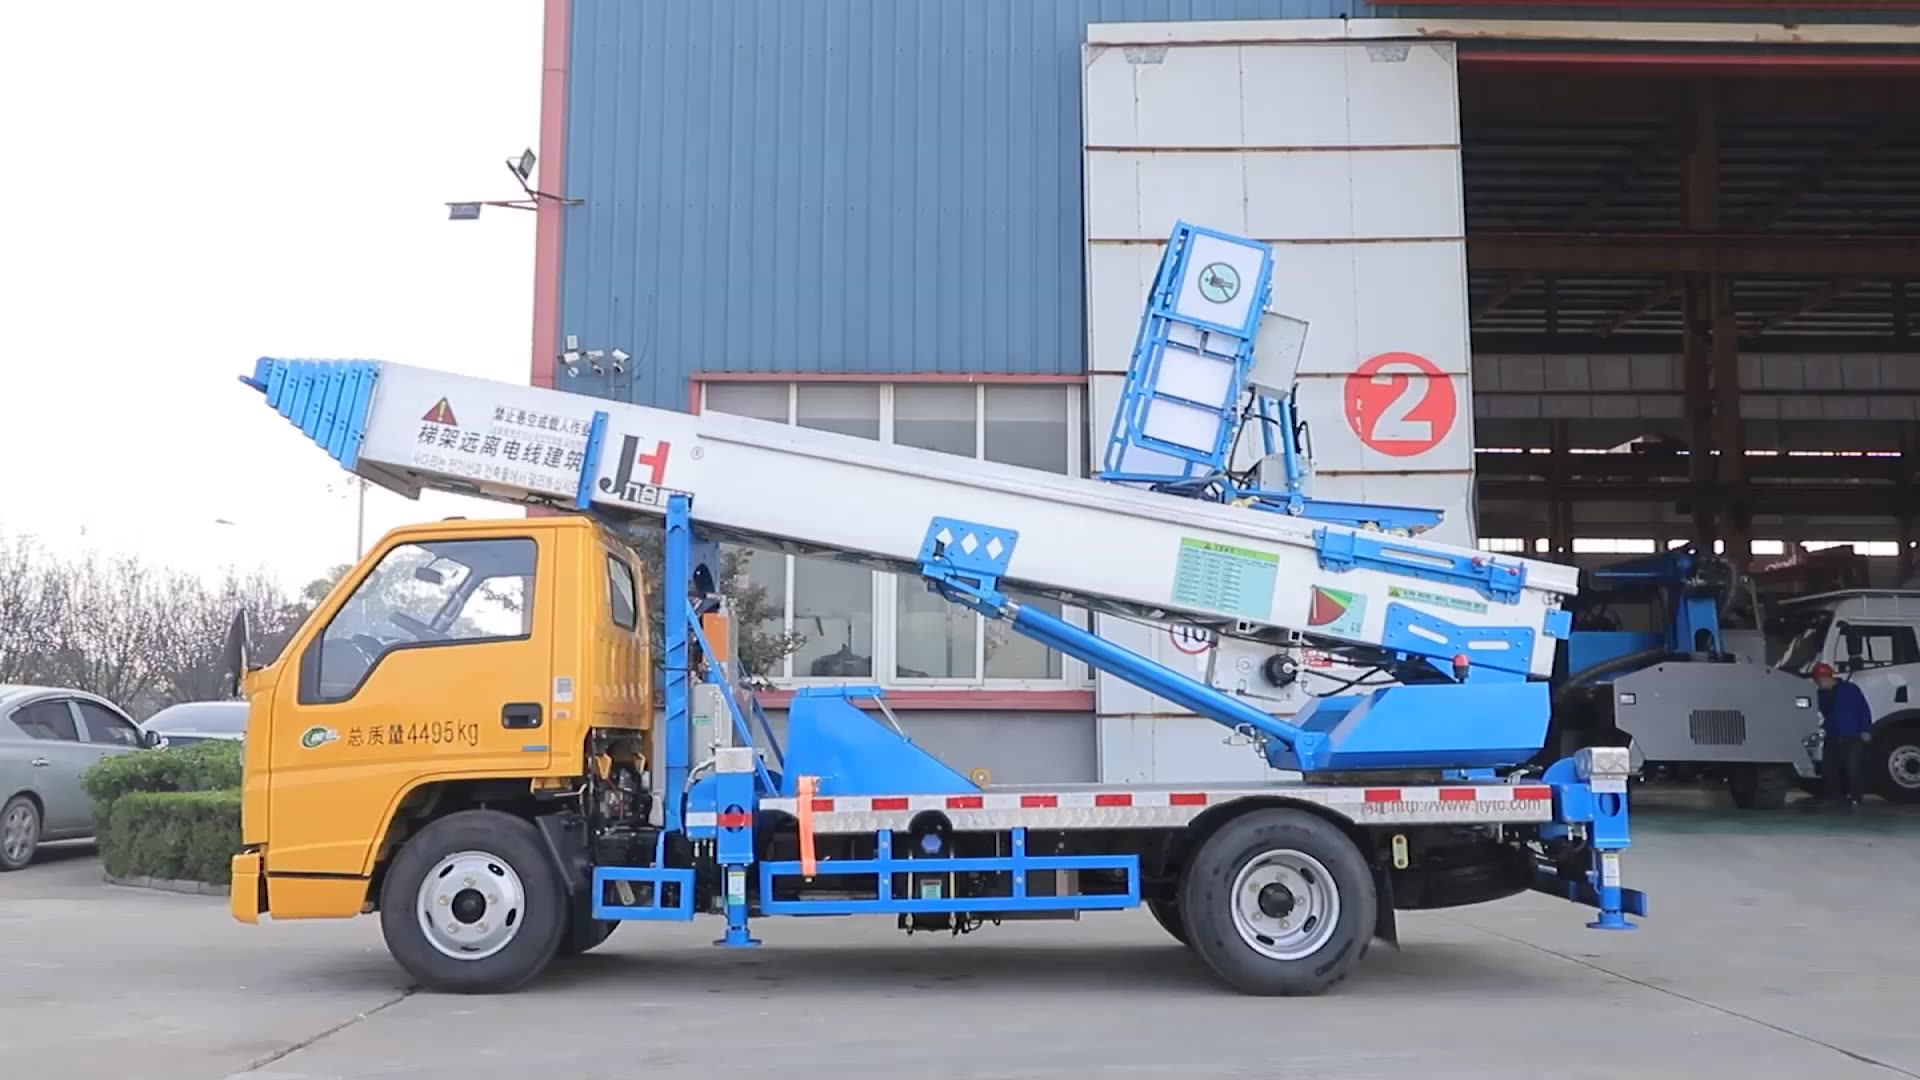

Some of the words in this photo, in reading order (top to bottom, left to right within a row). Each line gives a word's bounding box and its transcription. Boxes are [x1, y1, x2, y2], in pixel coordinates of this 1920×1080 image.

[1371, 362, 1432, 441] 2
[417, 423, 583, 472] 梯架远离电线建筑
[347, 720, 480, 746] 总质量4495kg
